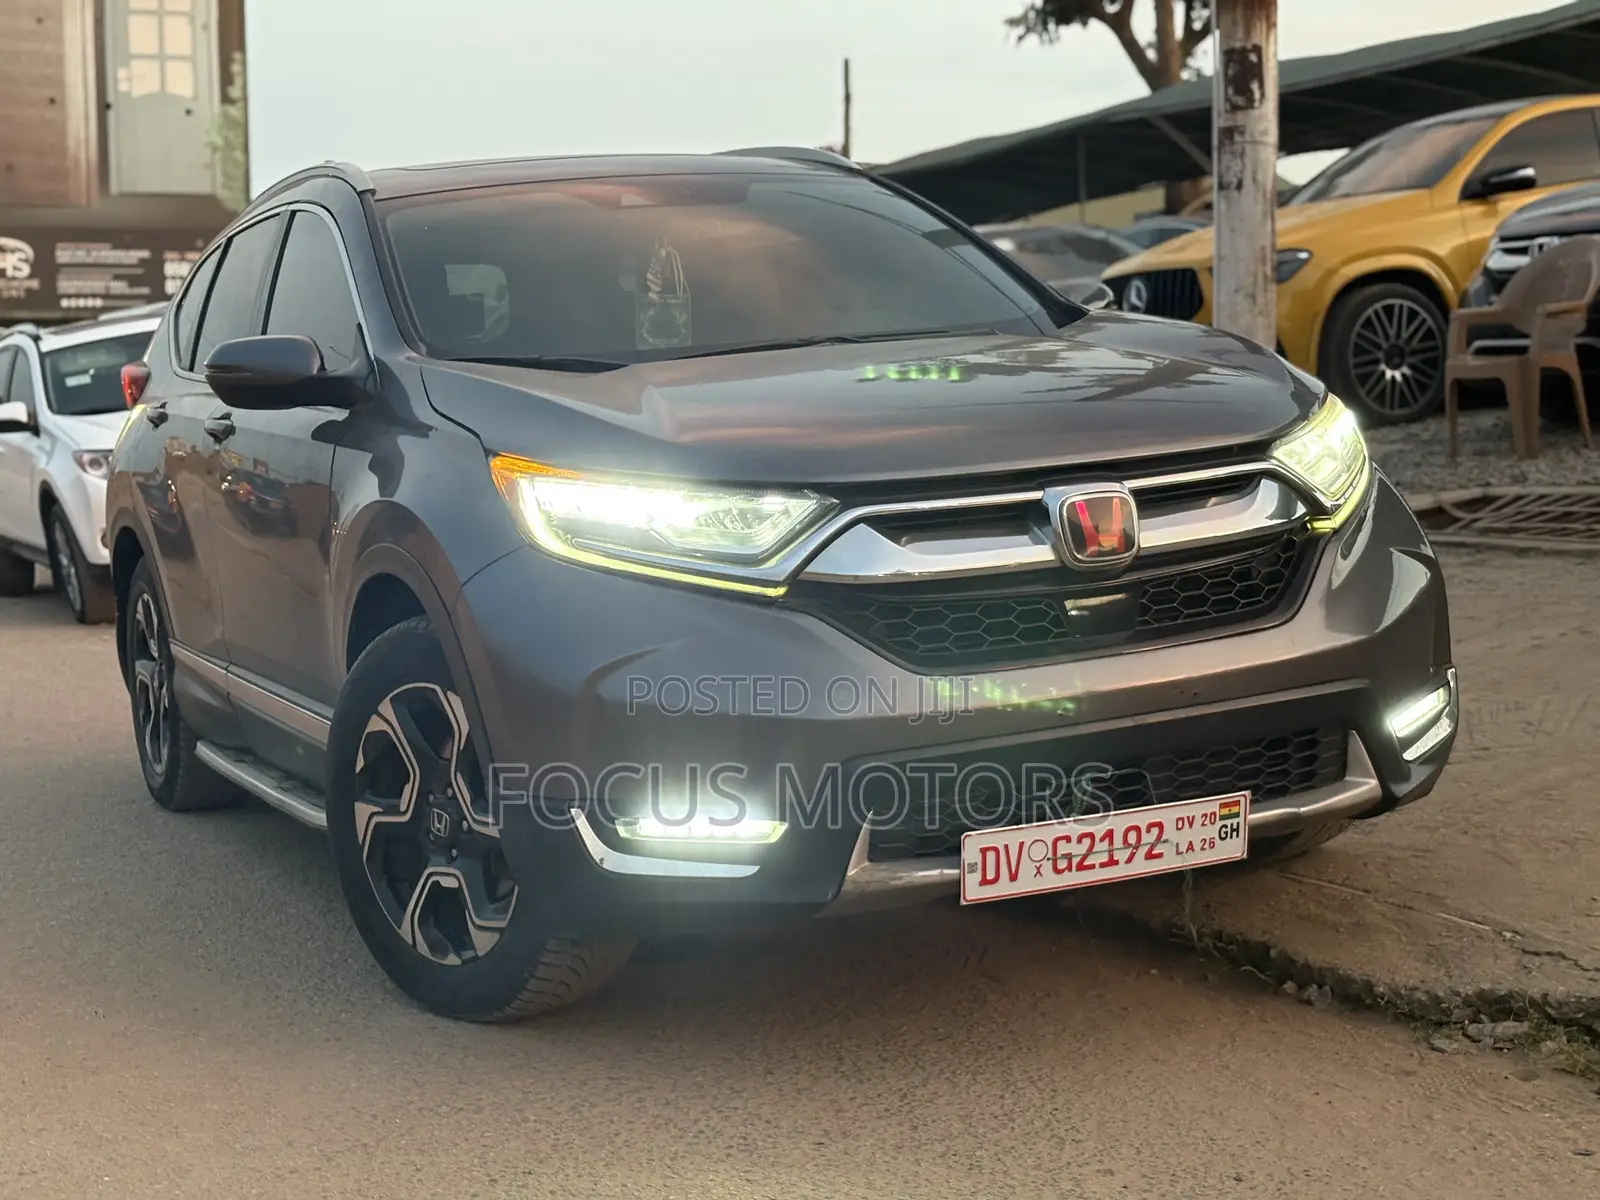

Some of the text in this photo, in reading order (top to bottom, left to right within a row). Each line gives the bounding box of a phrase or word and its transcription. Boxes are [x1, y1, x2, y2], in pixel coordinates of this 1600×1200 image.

[1175, 810, 1217, 831] DV 20
[1217, 821, 1240, 841] GH
[978, 840, 1025, 887] DV
[1051, 820, 1165, 875] G2192
[1175, 836, 1216, 855] LA 26
